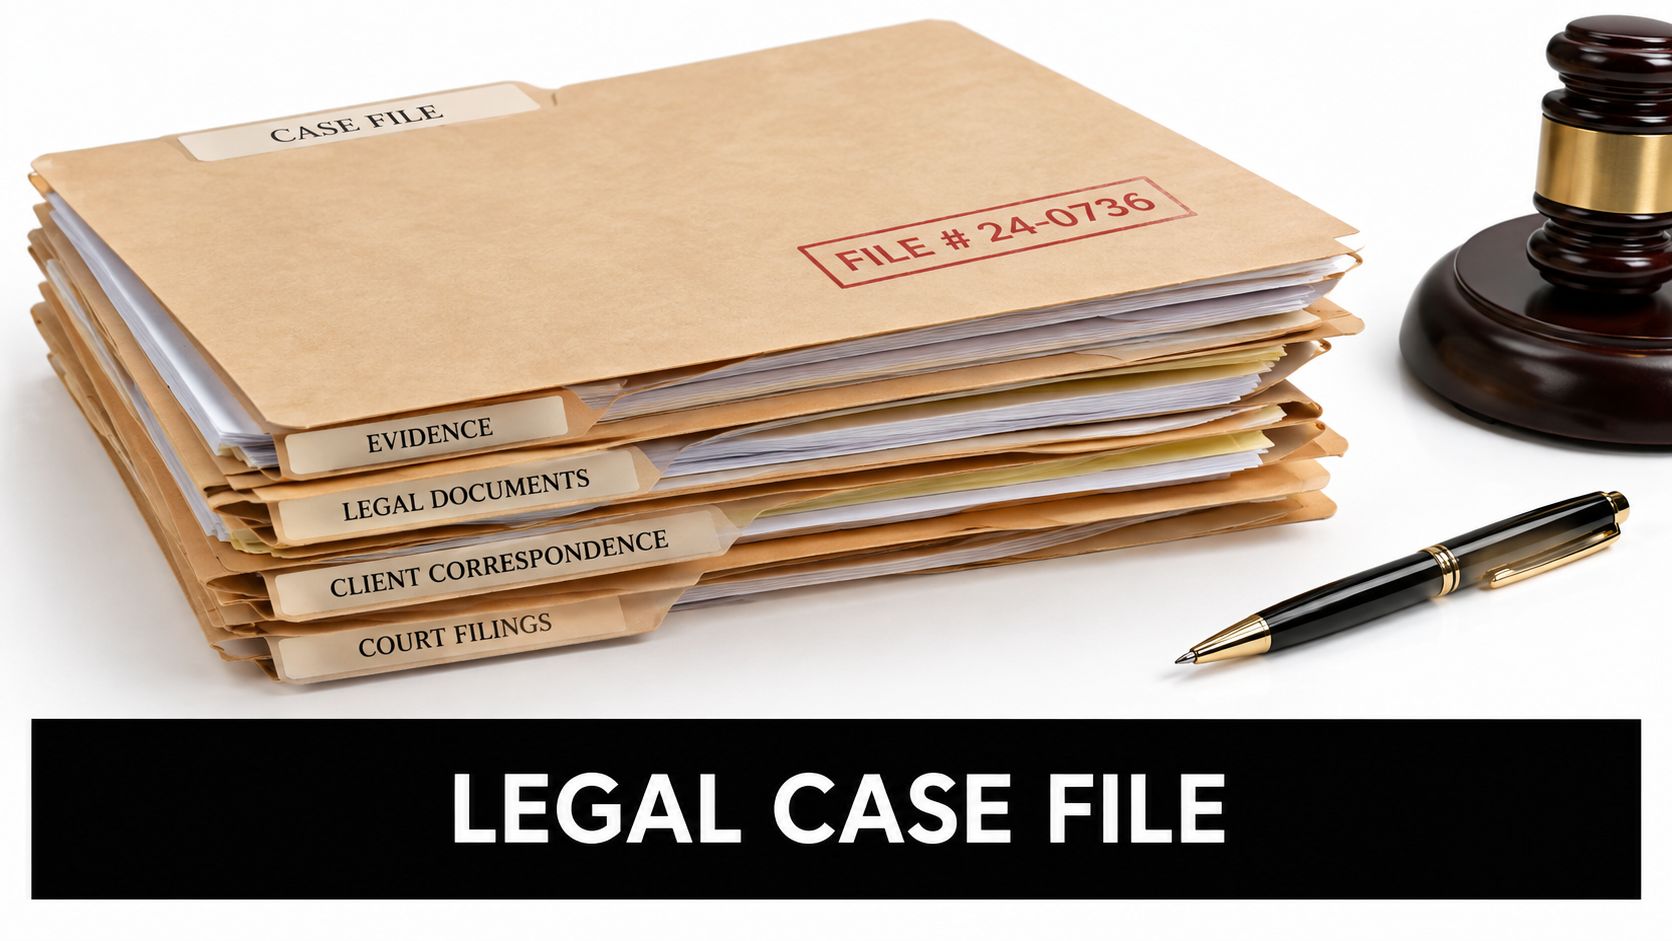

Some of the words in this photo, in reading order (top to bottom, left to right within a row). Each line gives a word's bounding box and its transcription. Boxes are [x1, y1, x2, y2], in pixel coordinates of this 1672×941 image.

[270, 118, 360, 144] CASE
[364, 105, 444, 130] FILE
[835, 237, 936, 271] FILE
[941, 228, 971, 251] #
[977, 192, 1156, 243] 24-0736
[367, 417, 494, 453] EVIDENCE
[341, 492, 425, 522] LEGAL
[430, 468, 590, 509] DOCUMENTS
[330, 566, 421, 598] CLIENT
[428, 529, 670, 584] CORRESPONDENCE
[358, 627, 447, 658] COURT
[454, 612, 553, 645] FILINGS
